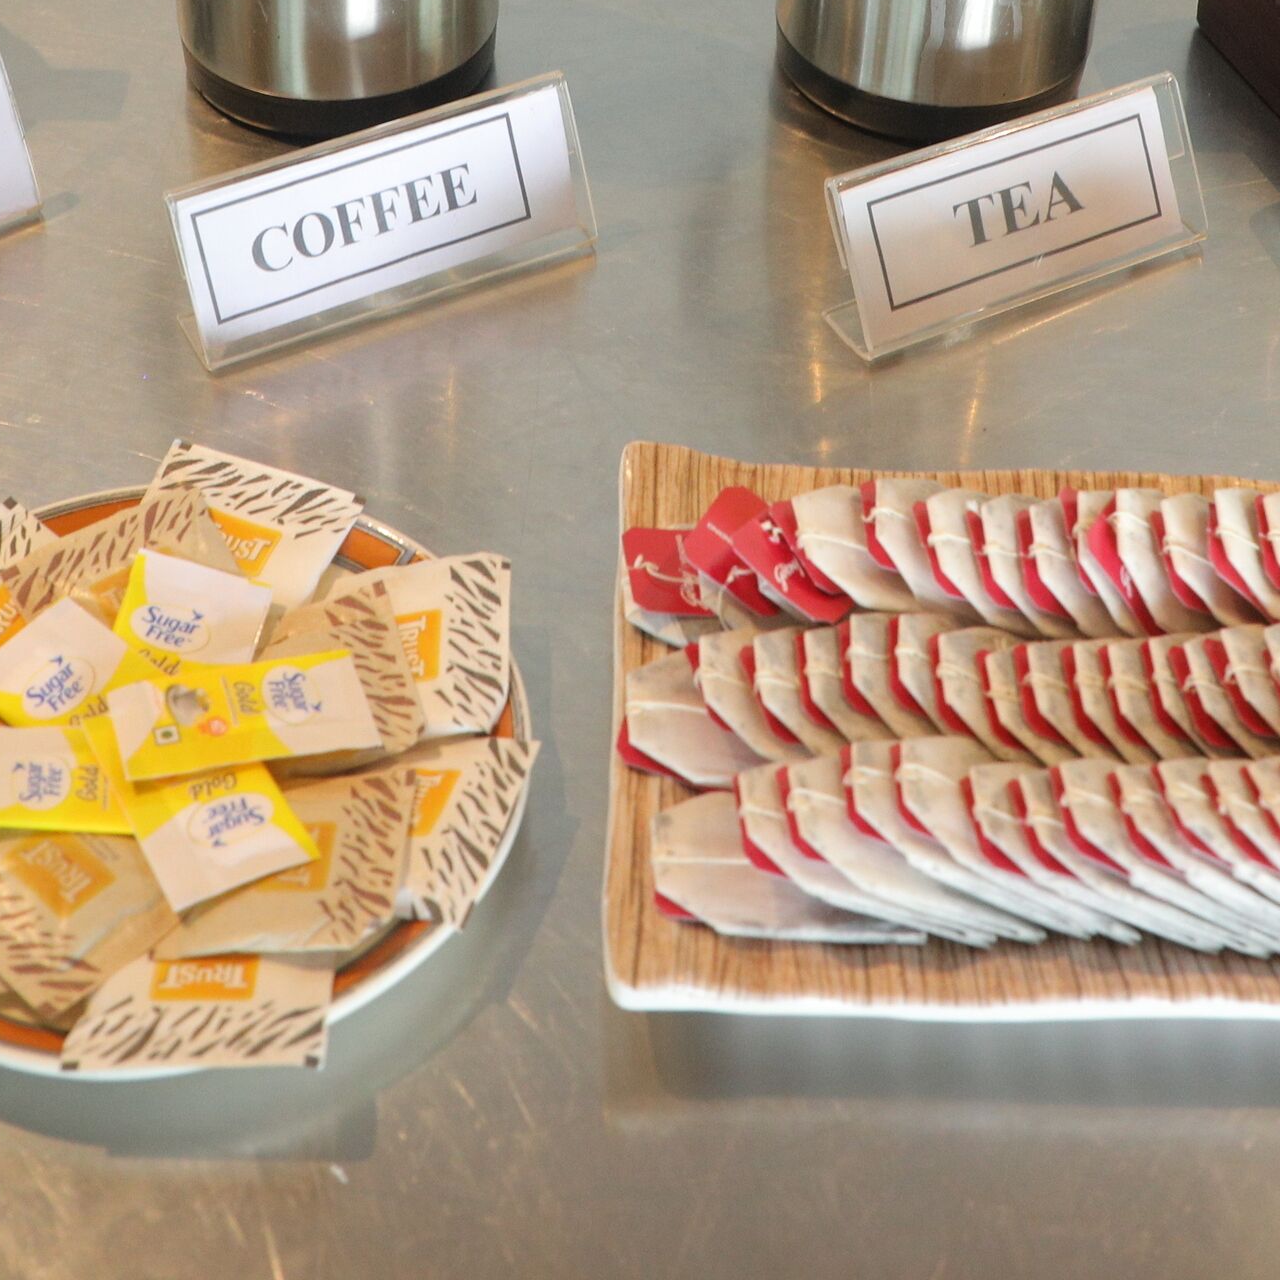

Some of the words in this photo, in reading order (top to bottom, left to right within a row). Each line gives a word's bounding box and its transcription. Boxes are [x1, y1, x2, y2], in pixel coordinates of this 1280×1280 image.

[251, 163, 478, 271] COFFEE
[952, 170, 1086, 248] TEA
[141, 606, 200, 634] Sugar
[145, 624, 185, 647] Free
[26, 663, 74, 707] Sugar
[47, 678, 83, 712] Free
[268, 680, 288, 711] Free
[282, 672, 309, 713] Sugar
[18, 762, 46, 802] Sugar
[43, 767, 62, 797] Free
[75, 764, 99, 802] Gold
[188, 772, 237, 800] Gold
[206, 809, 266, 838] Sugar
[207, 798, 248, 819] Free
